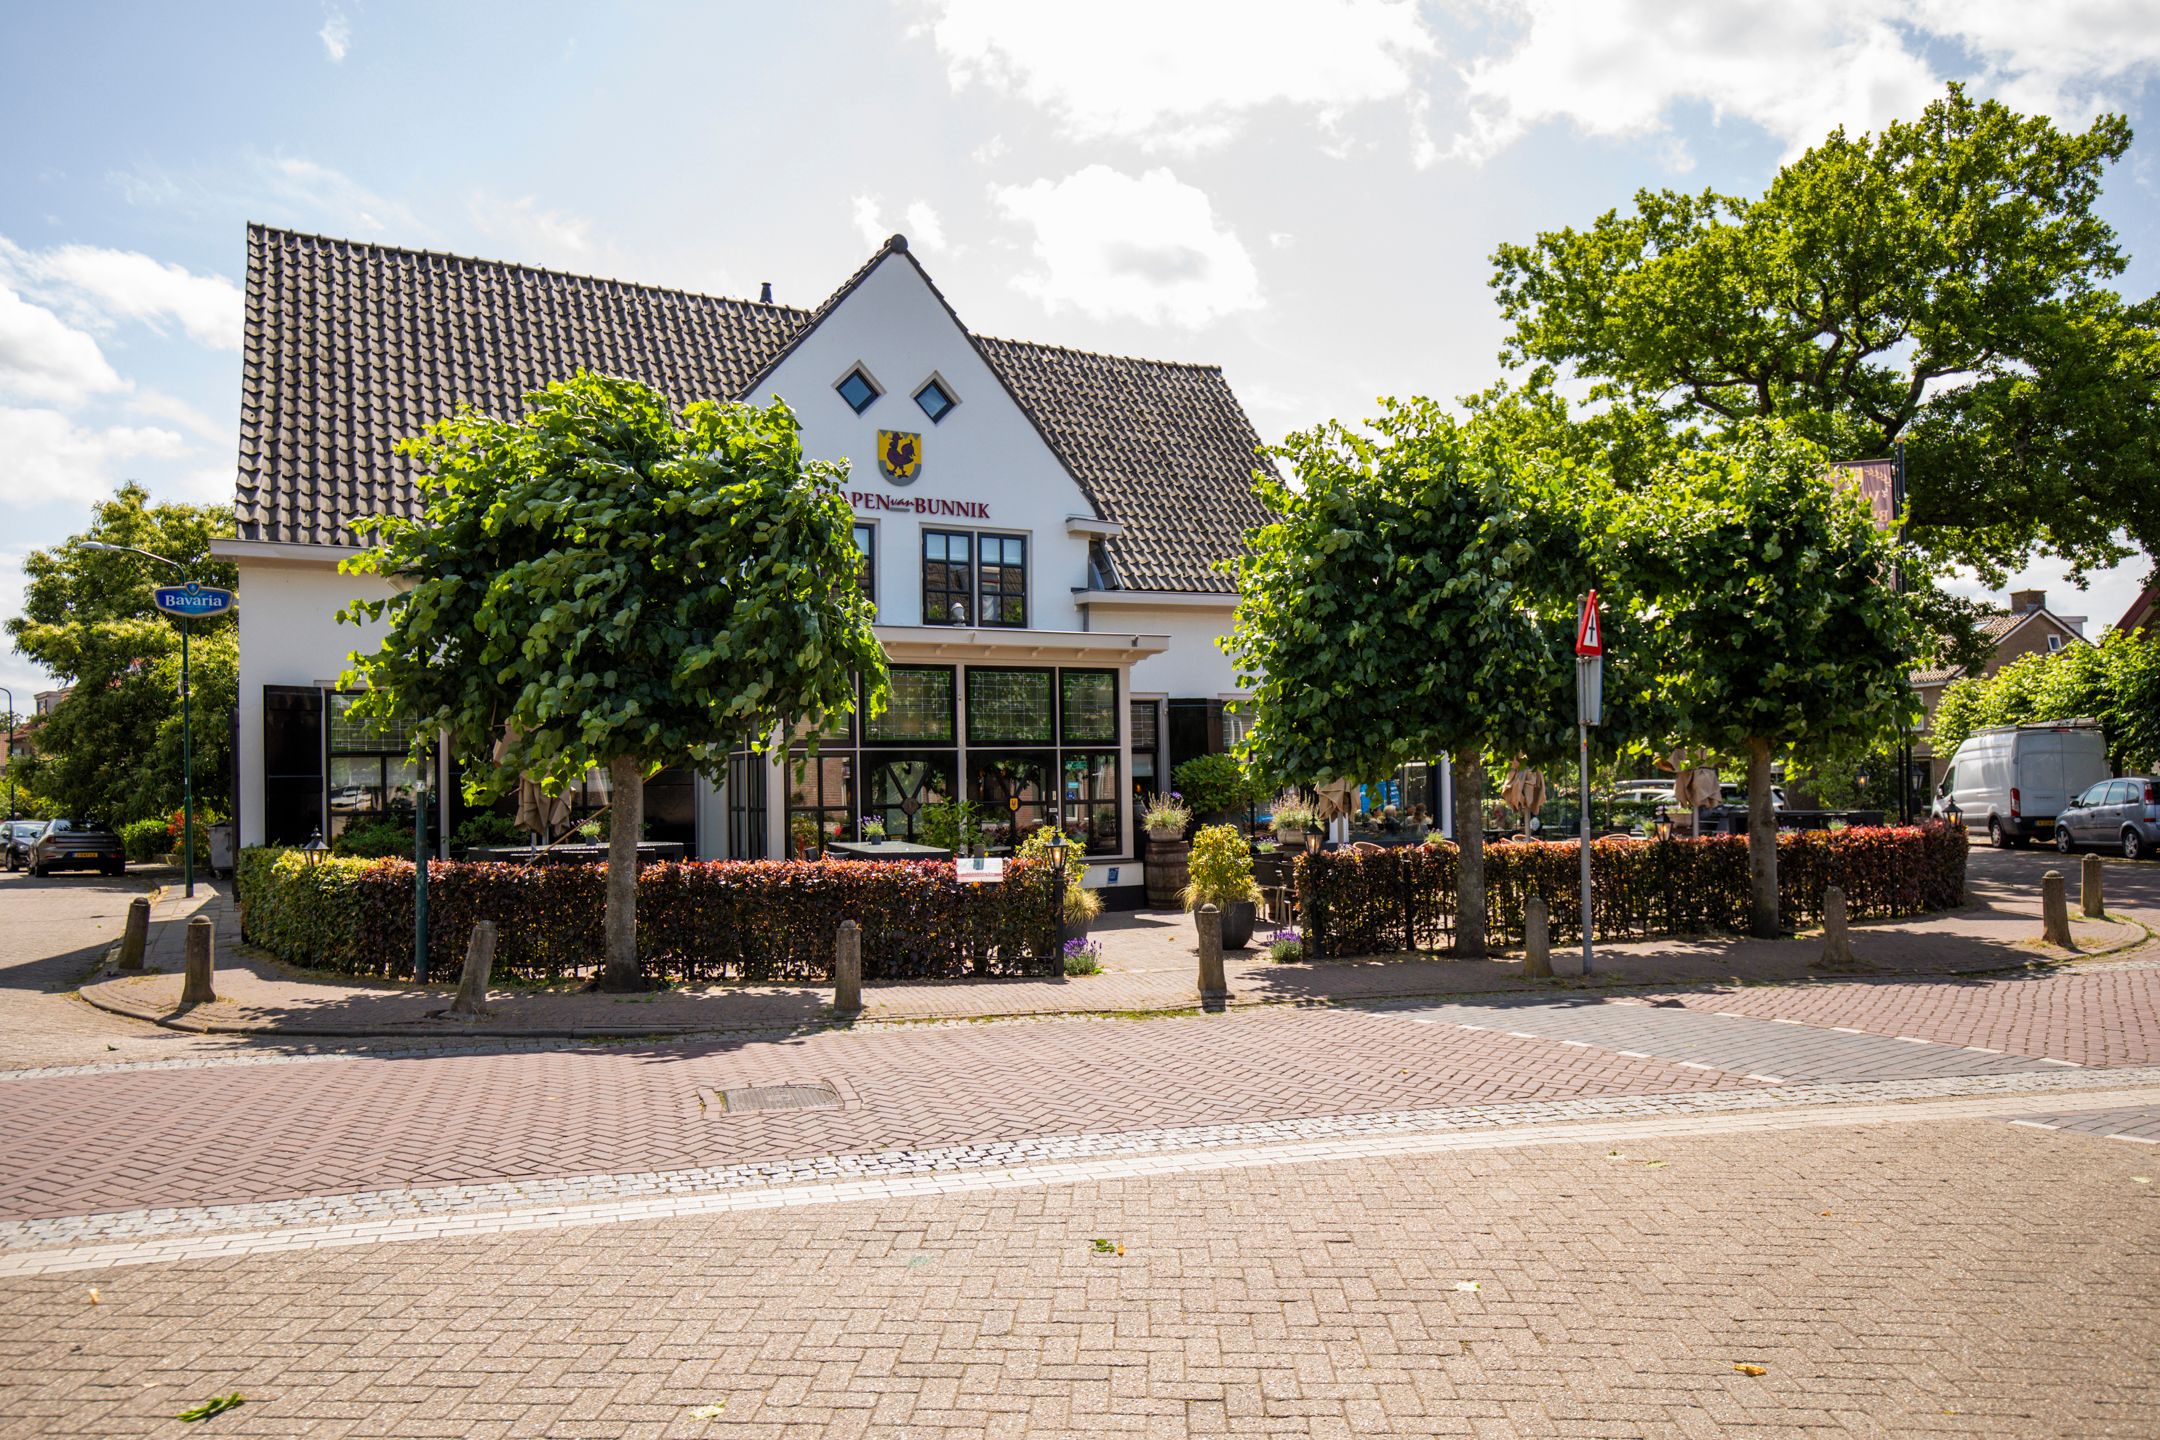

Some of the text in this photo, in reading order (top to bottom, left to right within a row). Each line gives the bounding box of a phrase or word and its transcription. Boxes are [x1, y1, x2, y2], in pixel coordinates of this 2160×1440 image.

[890, 497, 914, 507] van
[915, 497, 990, 519] BUNNIK
[165, 595, 222, 607] Bavaria
